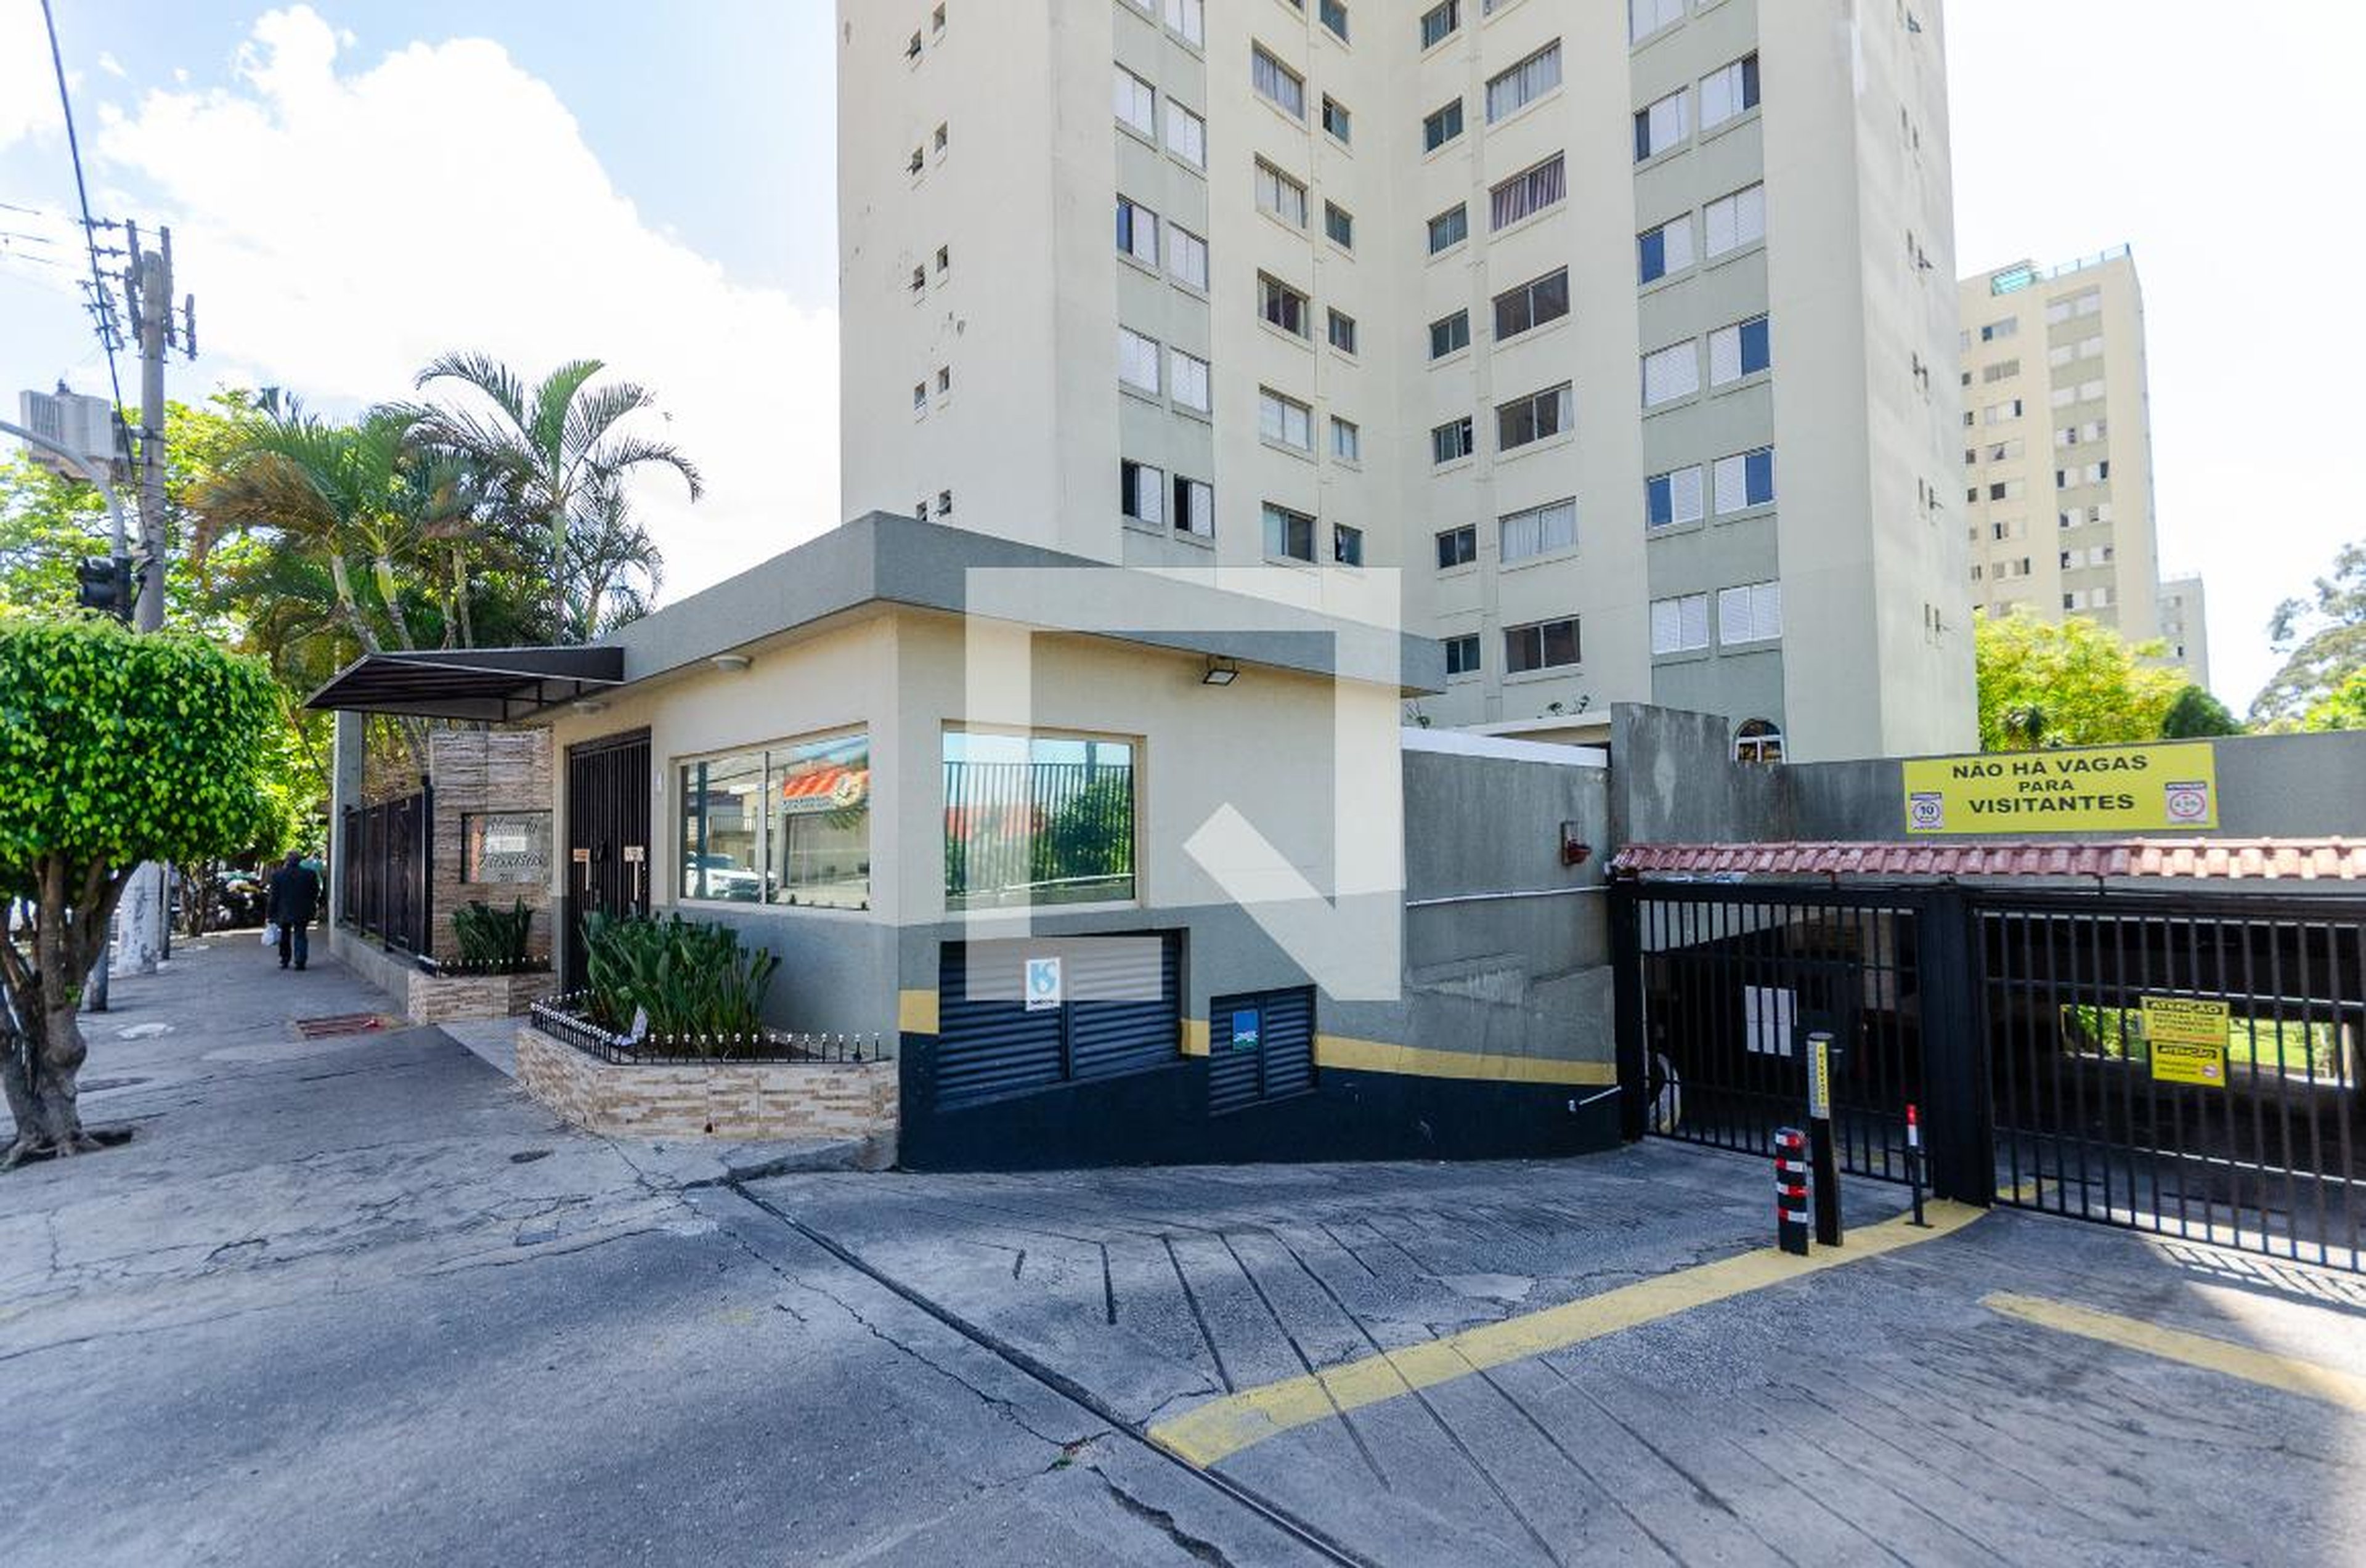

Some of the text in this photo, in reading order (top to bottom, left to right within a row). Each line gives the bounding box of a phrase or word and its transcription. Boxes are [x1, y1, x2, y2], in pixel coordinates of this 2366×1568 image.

[1952, 755, 2148, 779] NÃO HÁ VAGAS
[2018, 779, 2075, 793] PARA
[1921, 805, 1934, 815] 10
[1969, 794, 2135, 814] VISITANTES
